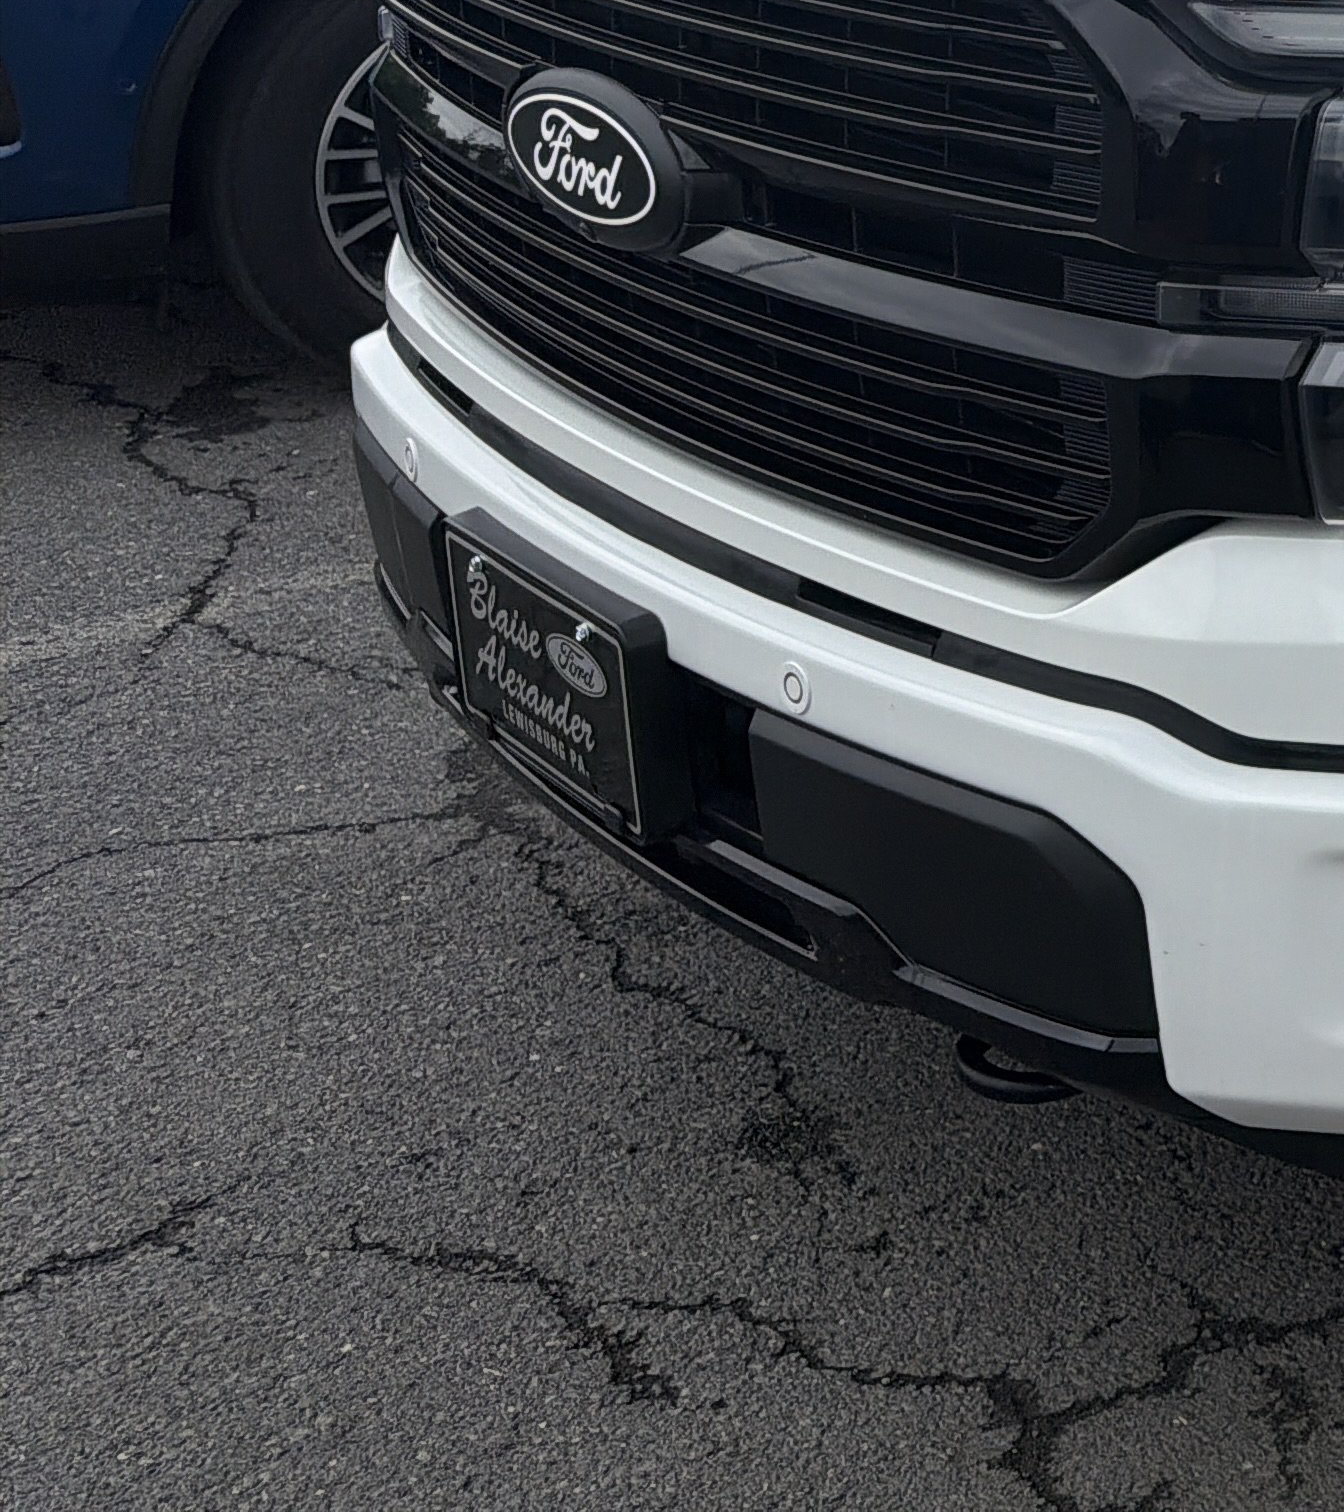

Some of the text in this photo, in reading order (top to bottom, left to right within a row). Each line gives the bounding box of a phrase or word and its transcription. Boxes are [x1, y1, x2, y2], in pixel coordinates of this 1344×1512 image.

[533, 107, 623, 210] Ford
[467, 571, 542, 659] Blaise
[476, 635, 595, 753] Alexander
[558, 641, 595, 689] Ford
[501, 699, 566, 761] LEWISBURG
